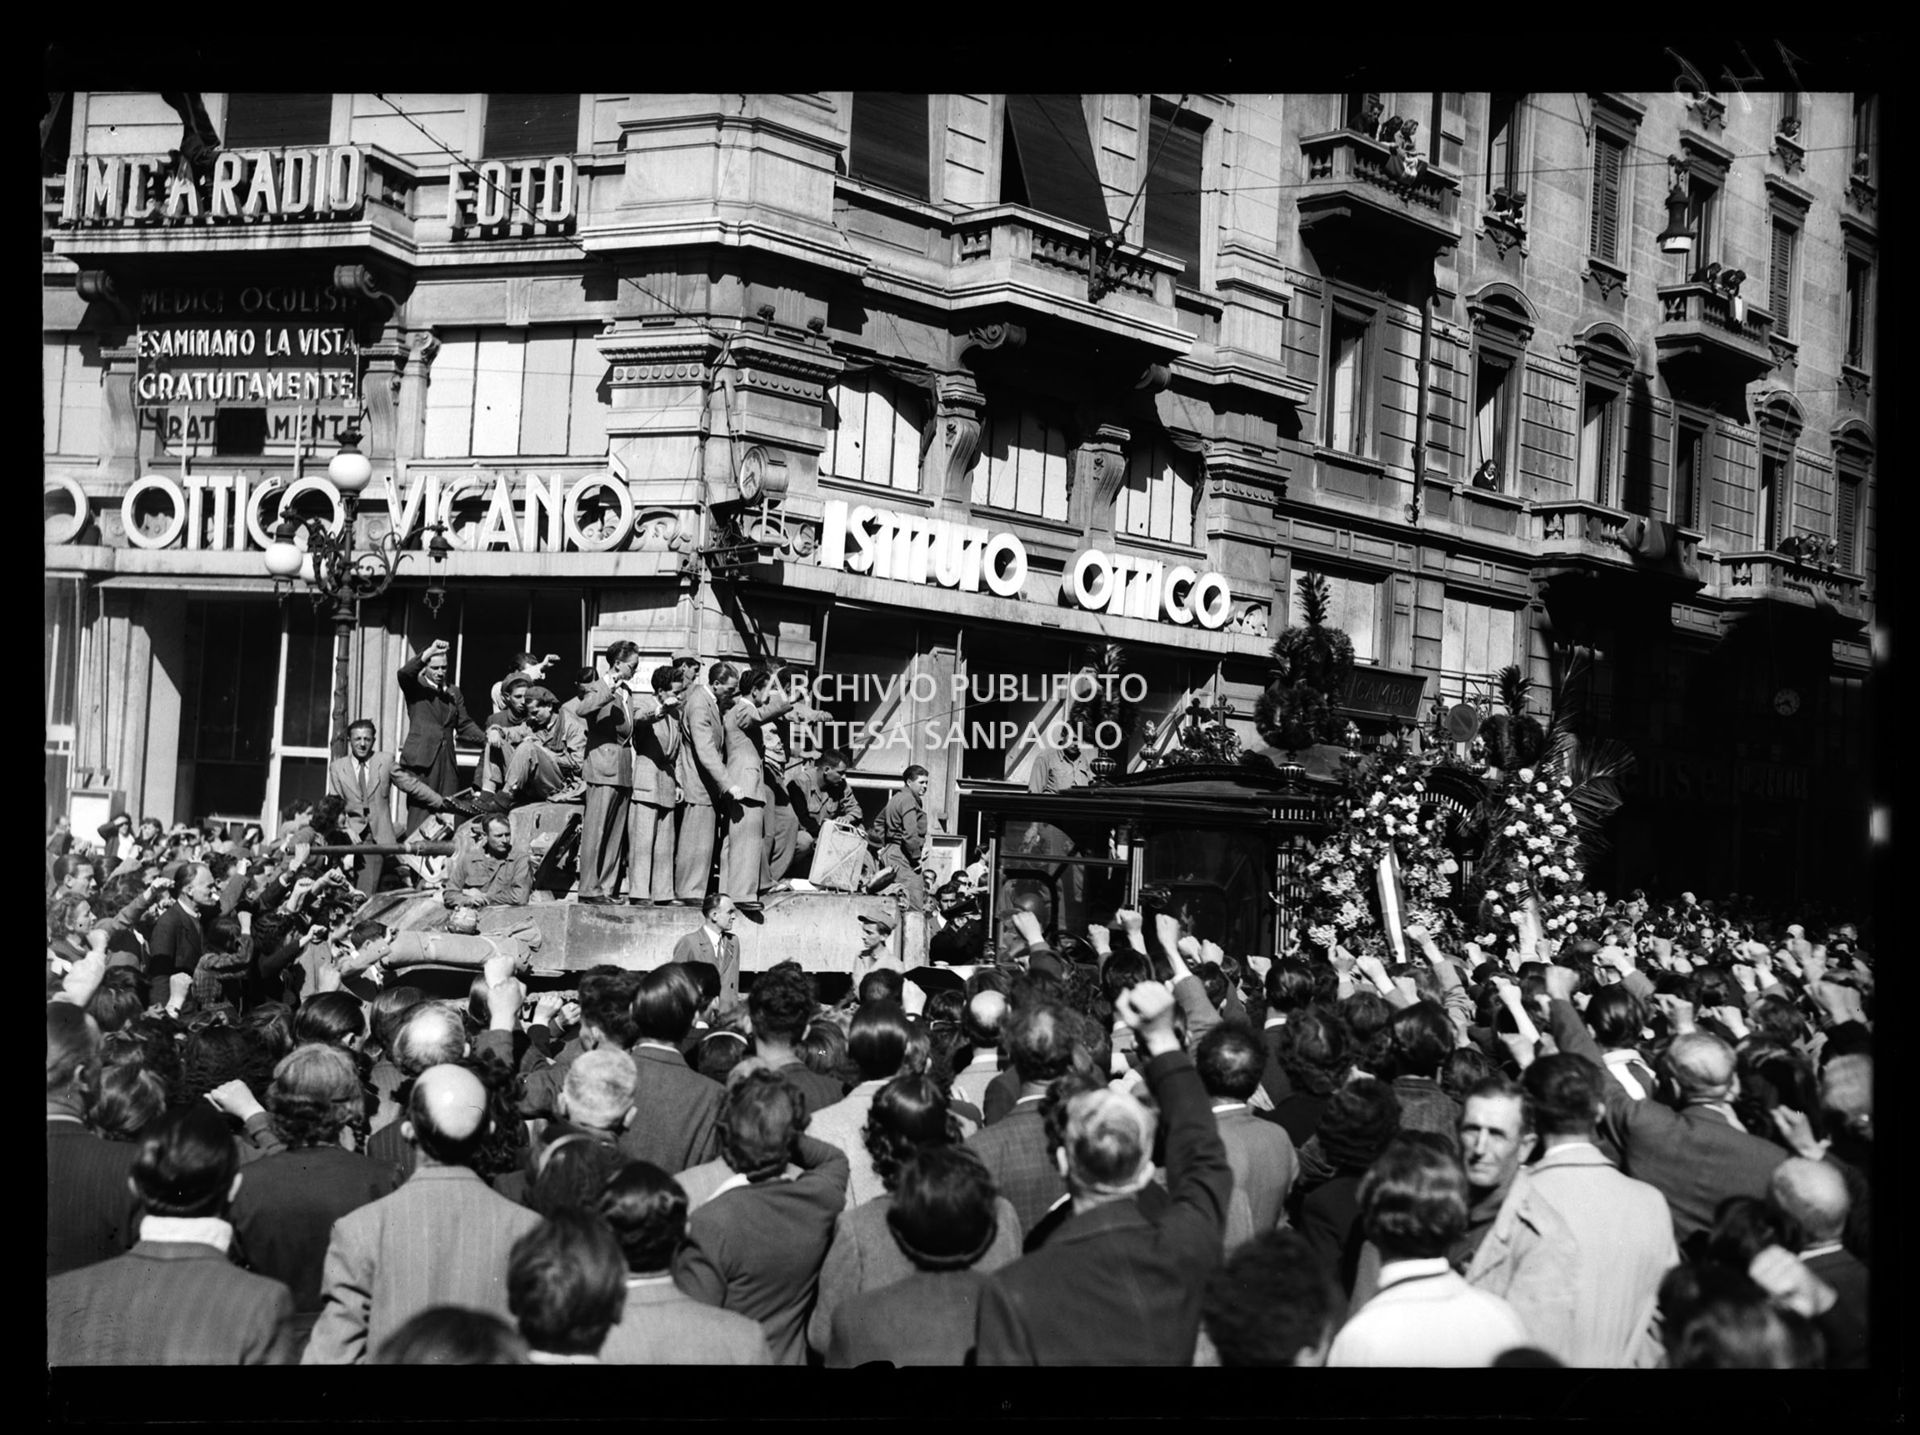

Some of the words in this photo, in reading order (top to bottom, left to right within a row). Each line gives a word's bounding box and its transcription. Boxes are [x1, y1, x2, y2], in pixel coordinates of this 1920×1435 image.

[447, 157, 577, 229] FOTO
[141, 287, 224, 313] MEDICI
[138, 328, 256, 358] ESAMINANO
[265, 328, 291, 357] LA
[298, 327, 357, 357] VISTA
[138, 371, 355, 401] GRATUITAMENTE
[120, 474, 345, 551] OTTICO
[821, 500, 1028, 597] ISTITUTO
[1062, 548, 1232, 630] OTTICO
[1356, 679, 1416, 706] CAMBIO
